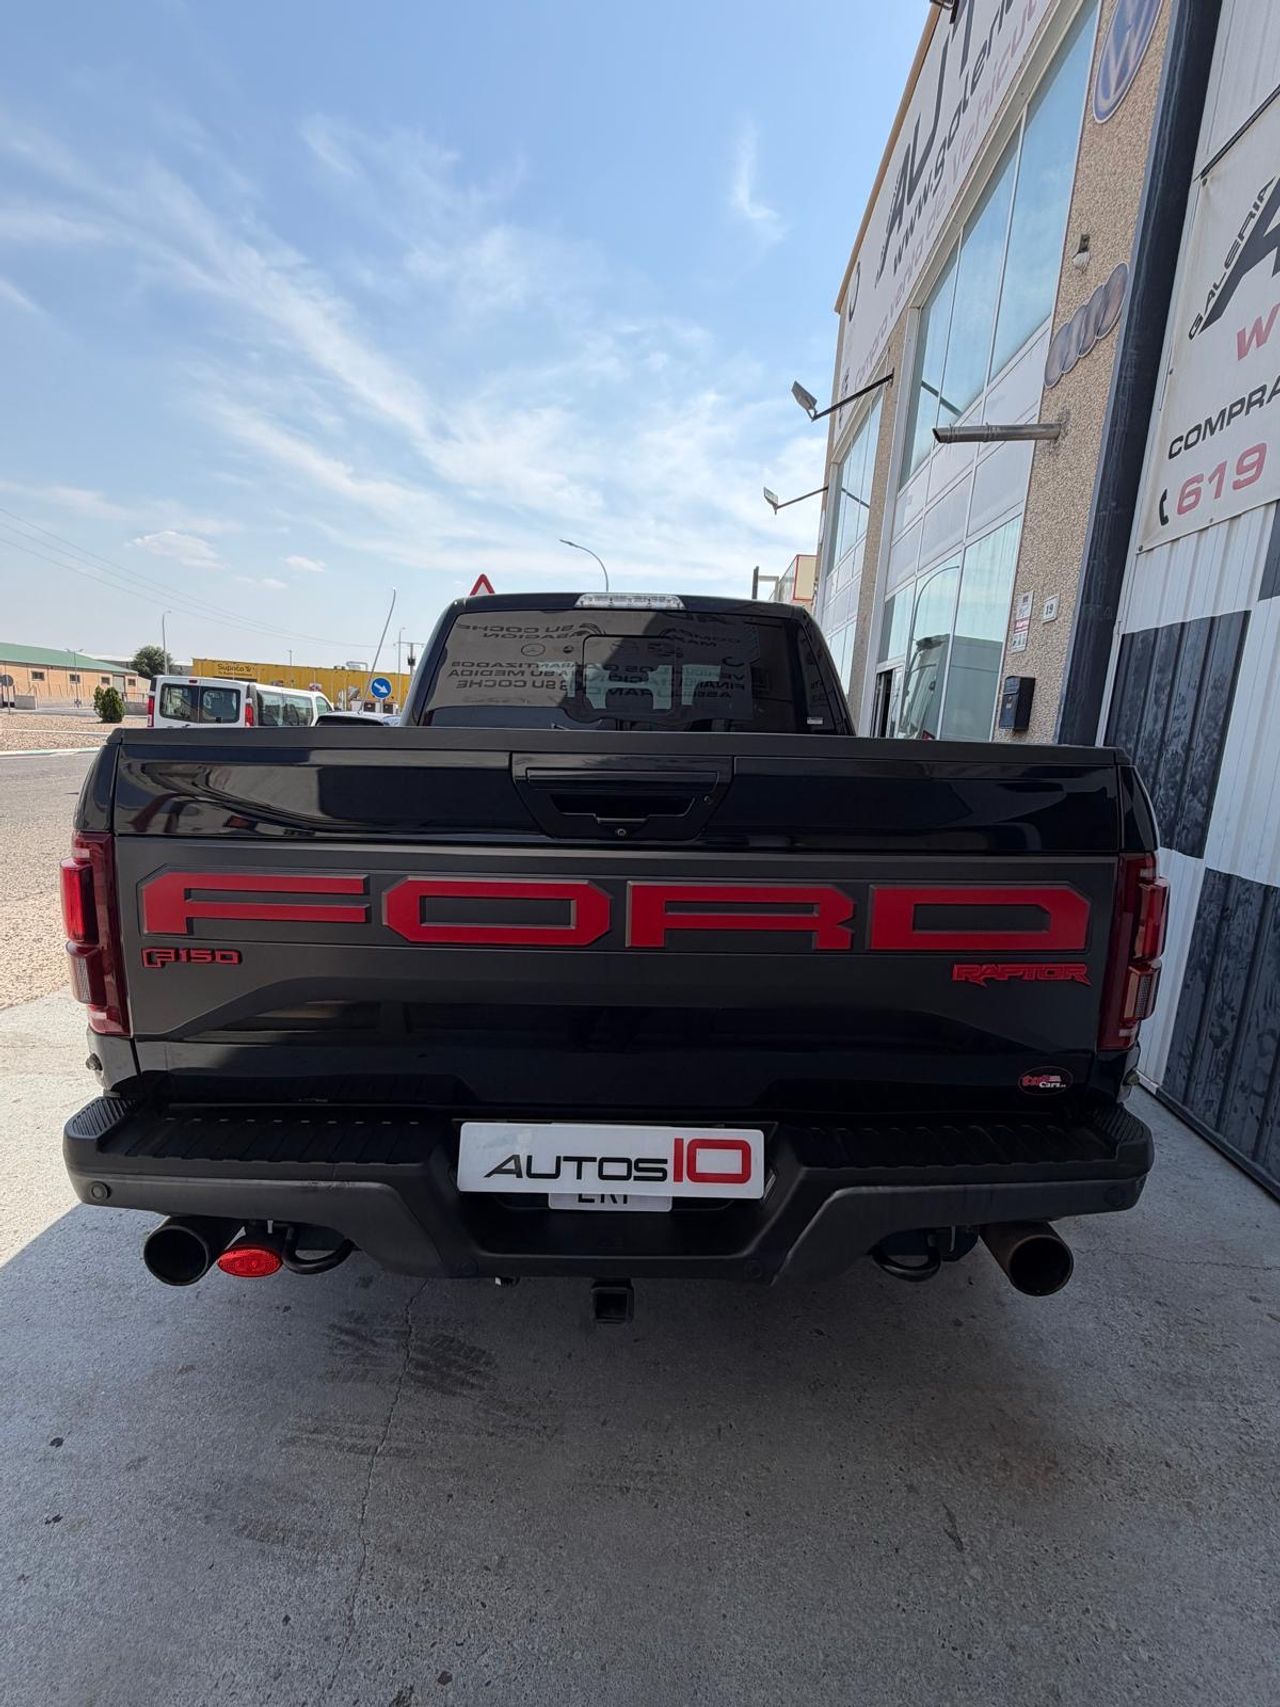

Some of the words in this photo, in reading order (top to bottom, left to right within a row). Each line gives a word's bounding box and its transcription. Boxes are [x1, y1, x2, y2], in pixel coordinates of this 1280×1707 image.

[1189, 175, 1276, 341] GALERIA
[1177, 442, 1267, 515] 619
[140, 873, 1092, 951] FORD
[952, 963, 1092, 987] RAPTOR
